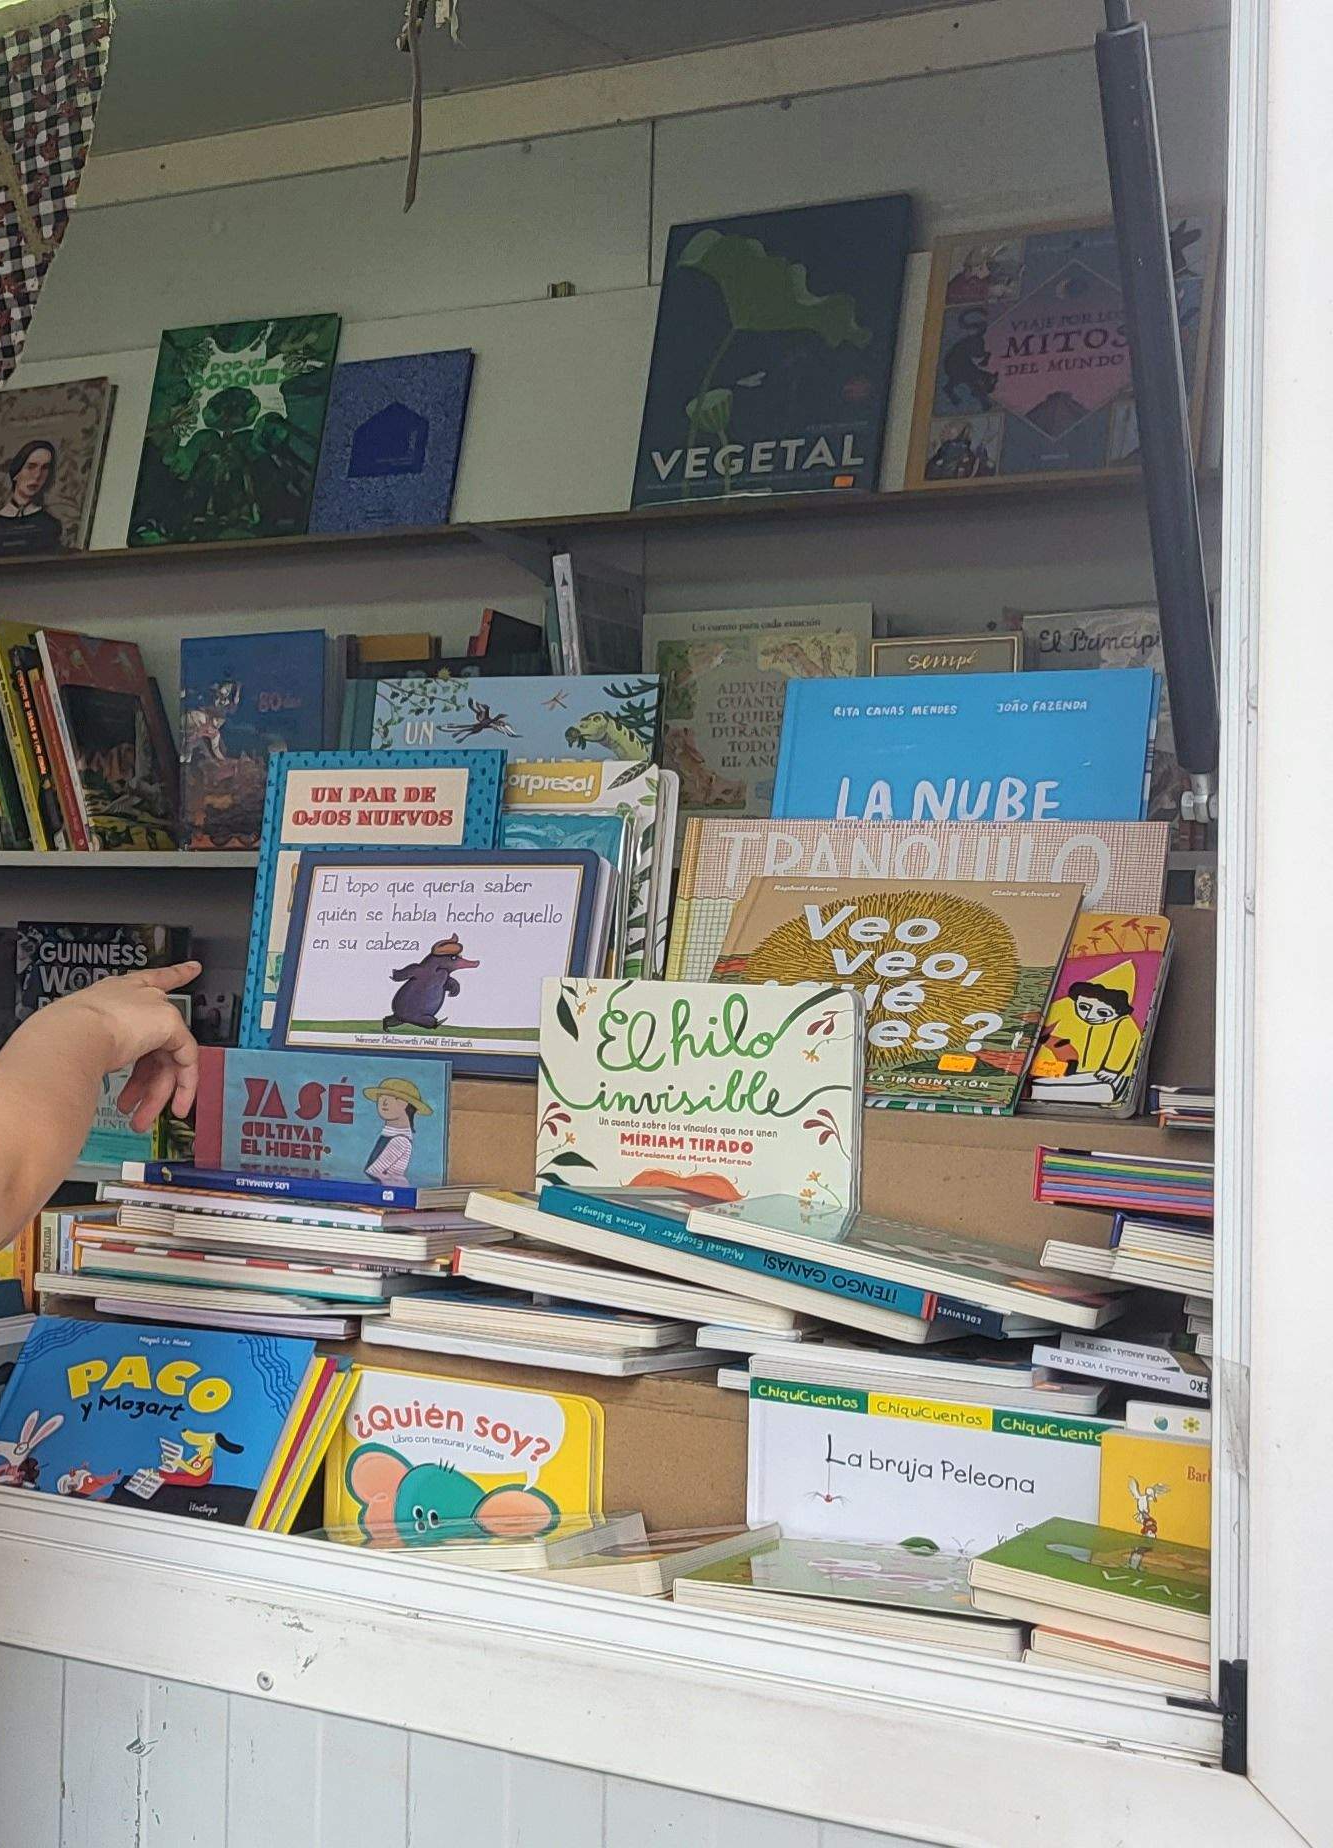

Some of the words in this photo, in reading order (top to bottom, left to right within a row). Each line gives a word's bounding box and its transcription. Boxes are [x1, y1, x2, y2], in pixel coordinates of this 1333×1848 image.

[1000, 324, 1129, 358] MITOS
[1005, 363, 1039, 376] DEL
[1047, 354, 1124, 373] MUNDO
[651, 434, 865, 481] VEGETAL
[1039, 629, 1061, 654] El
[708, 711, 727, 724] TE
[833, 706, 860, 718] RITA
[866, 705, 905, 716] CANAS
[911, 704, 958, 716] MENDES
[996, 699, 1028, 713] JOÃO
[1032, 700, 1087, 712] FAZENDA
[405, 721, 434, 745] UN
[728, 741, 777, 752] TODO
[721, 756, 742, 767] EL
[311, 786, 344, 803] UN
[349, 786, 398, 803] PAR
[404, 786, 437, 803] DE
[836, 776, 893, 821] LA
[912, 776, 1060, 821] NUBE
[292, 810, 352, 827] OJOS
[356, 809, 453, 827] NUEVOS
[321, 874, 338, 893] El
[346, 876, 379, 897] topo
[386, 881, 415, 899] que
[423, 878, 474, 899] quería
[484, 874, 533, 893] saber
[992, 888, 1023, 898] Claire
[317, 907, 357, 926] quién
[366, 911, 383, 922] se
[392, 903, 437, 923] había
[446, 904, 495, 923] hecho
[502, 903, 563, 928] aquello
[803, 903, 941, 944] Veo
[312, 938, 329, 950] en
[338, 939, 357, 951] su
[366, 932, 420, 951] cabeza
[39, 942, 148, 967] GUINNESS
[831, 947, 983, 988] veo,
[596, 1008, 666, 1073] El
[671, 992, 777, 1067] hilo
[867, 1011, 1003, 1052] es?
[868, 1073, 888, 1085] LA
[890, 1073, 989, 1089] IMAGINACIÓN
[242, 1077, 288, 1119] YA
[295, 1076, 355, 1124] SÉ
[588, 1068, 786, 1118] invisible
[241, 1121, 323, 1144] CULTIVAR
[599, 1117, 609, 1126] Un
[642, 1121, 666, 1131] sobre
[668, 1122, 681, 1132] los
[683, 1123, 718, 1135] vínculos
[720, 1126, 736, 1137] que
[738, 1128, 754, 1137] nos
[757, 1129, 778, 1138] unen
[240, 1138, 262, 1156] EL
[620, 1131, 684, 1149] MÍRIAM
[689, 1137, 754, 1154] TIRADO
[621, 1149, 675, 1161] Ilustraciones
[676, 1152, 686, 1161] de
[688, 1154, 717, 1164] Marta
[718, 1156, 752, 1167] Moreno
[235, 1178, 275, 1189] ANIMALES
[274, 1181, 290, 1190] LOS
[763, 1253, 828, 1284] GANAS!
[832, 1275, 899, 1305] ¡TENGO
[936, 1305, 982, 1326] EDELVIVES
[1050, 1354, 1063, 1363] SUS
[1064, 1357, 1075, 1365] DE
[1076, 1359, 1097, 1370] VICKY
[67, 1355, 232, 1414] PACO
[1141, 1372, 1171, 1385] SANDRA
[80, 1401, 93, 1422] y
[98, 1394, 185, 1421] Mozart
[757, 1383, 860, 1409] ChiquiCuentos
[876, 1400, 983, 1426] ChiquiCuentos
[353, 1400, 465, 1439] ¿Quién
[474, 1415, 551, 1462] soy?
[392, 1435, 414, 1444] Libro
[415, 1435, 431, 1444] con
[432, 1436, 465, 1449] texturas
[473, 1444, 505, 1461] solapas
[826, 1434, 862, 1469] La
[869, 1449, 934, 1484] bruja
[941, 1459, 1036, 1495] Peleona
